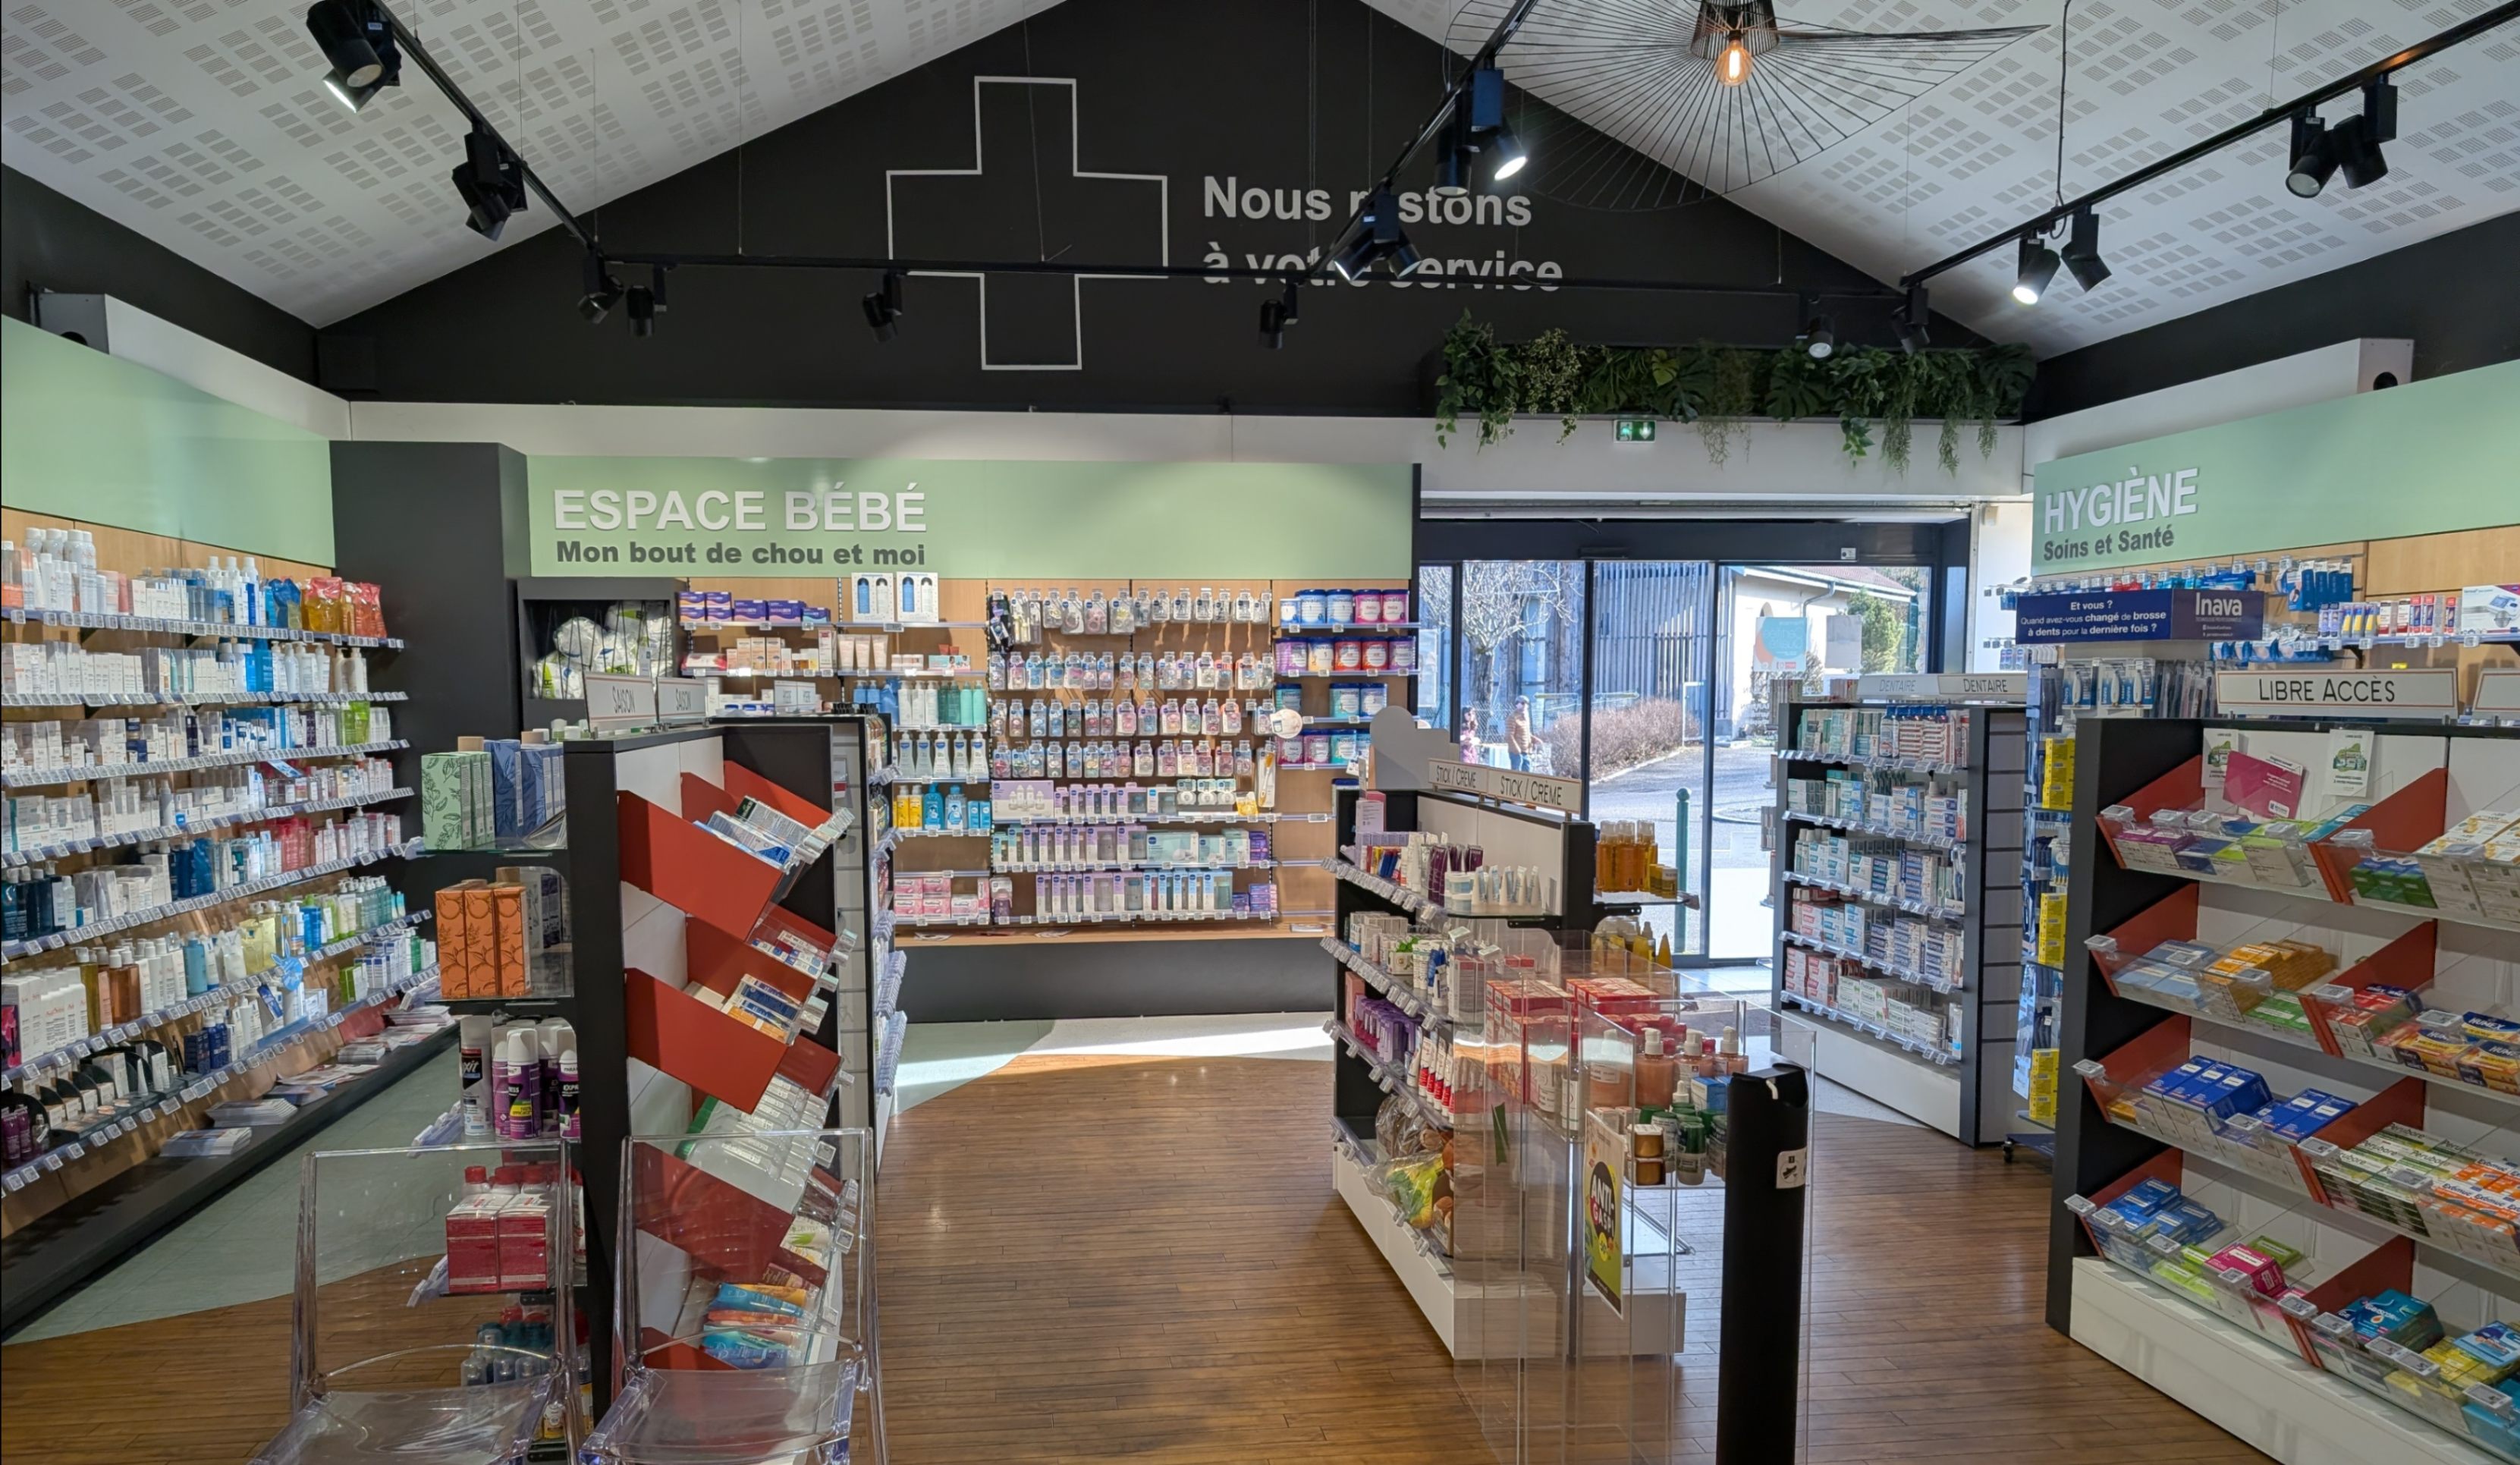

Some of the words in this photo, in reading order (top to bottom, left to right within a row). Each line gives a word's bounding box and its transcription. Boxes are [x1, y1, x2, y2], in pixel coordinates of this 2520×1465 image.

[1204, 176, 1331, 221] Nous
[1350, 186, 1532, 226] rstons
[1203, 241, 1230, 284] à
[1389, 250, 1563, 291] ervice
[554, 489, 767, 531] ESPACE
[785, 482, 926, 532] BÉBÉ
[2044, 466, 2198, 534] HYGIÈNE
[556, 540, 618, 563] Mon
[630, 542, 696, 564] bout
[705, 542, 742, 564] de
[752, 542, 824, 564] chou
[833, 544, 863, 564] et
[873, 544, 925, 565] moi
[2044, 539, 2088, 561] Soins
[2094, 533, 2113, 555] et
[2118, 524, 2174, 552] Santé
[2070, 602, 2081, 611] Et
[2082, 602, 2104, 610] vous
[2107, 600, 2113, 609] ?
[2195, 592, 2242, 616] Inava
[2020, 617, 2044, 625] Quand
[2046, 616, 2083, 624] avez-vous
[2085, 611, 2119, 623] changé
[2133, 611, 2167, 621] brosse
[2028, 627, 2034, 637] à
[2035, 627, 2060, 637] dents
[2062, 629, 2079, 637] pour
[2081, 627, 2088, 635] la
[2089, 625, 2129, 634] dernière
[2130, 624, 2148, 633] fois
[2151, 623, 2157, 632] ?
[1879, 679, 1916, 692] DENTAIRE
[1962, 678, 2008, 693] DENTAIRE
[2259, 678, 2314, 701] LIBRE
[2323, 675, 2395, 703] ACCÈS
[612, 685, 636, 713] SAISON
[676, 688, 691, 711] SAISON
[1436, 765, 1450, 782] STICK
[1451, 769, 1455, 784] /
[1500, 775, 1522, 798] STICK
[1524, 778, 1529, 801] /
[1531, 780, 1562, 806] CRÈME
[2468, 1017, 2505, 1030] HUMEX
[2390, 1123, 2425, 1139] Perubore
[2340, 1152, 2367, 1165] rubore
[2363, 1140, 2399, 1156] Perubore
[1592, 1202, 1614, 1237] GASPI
